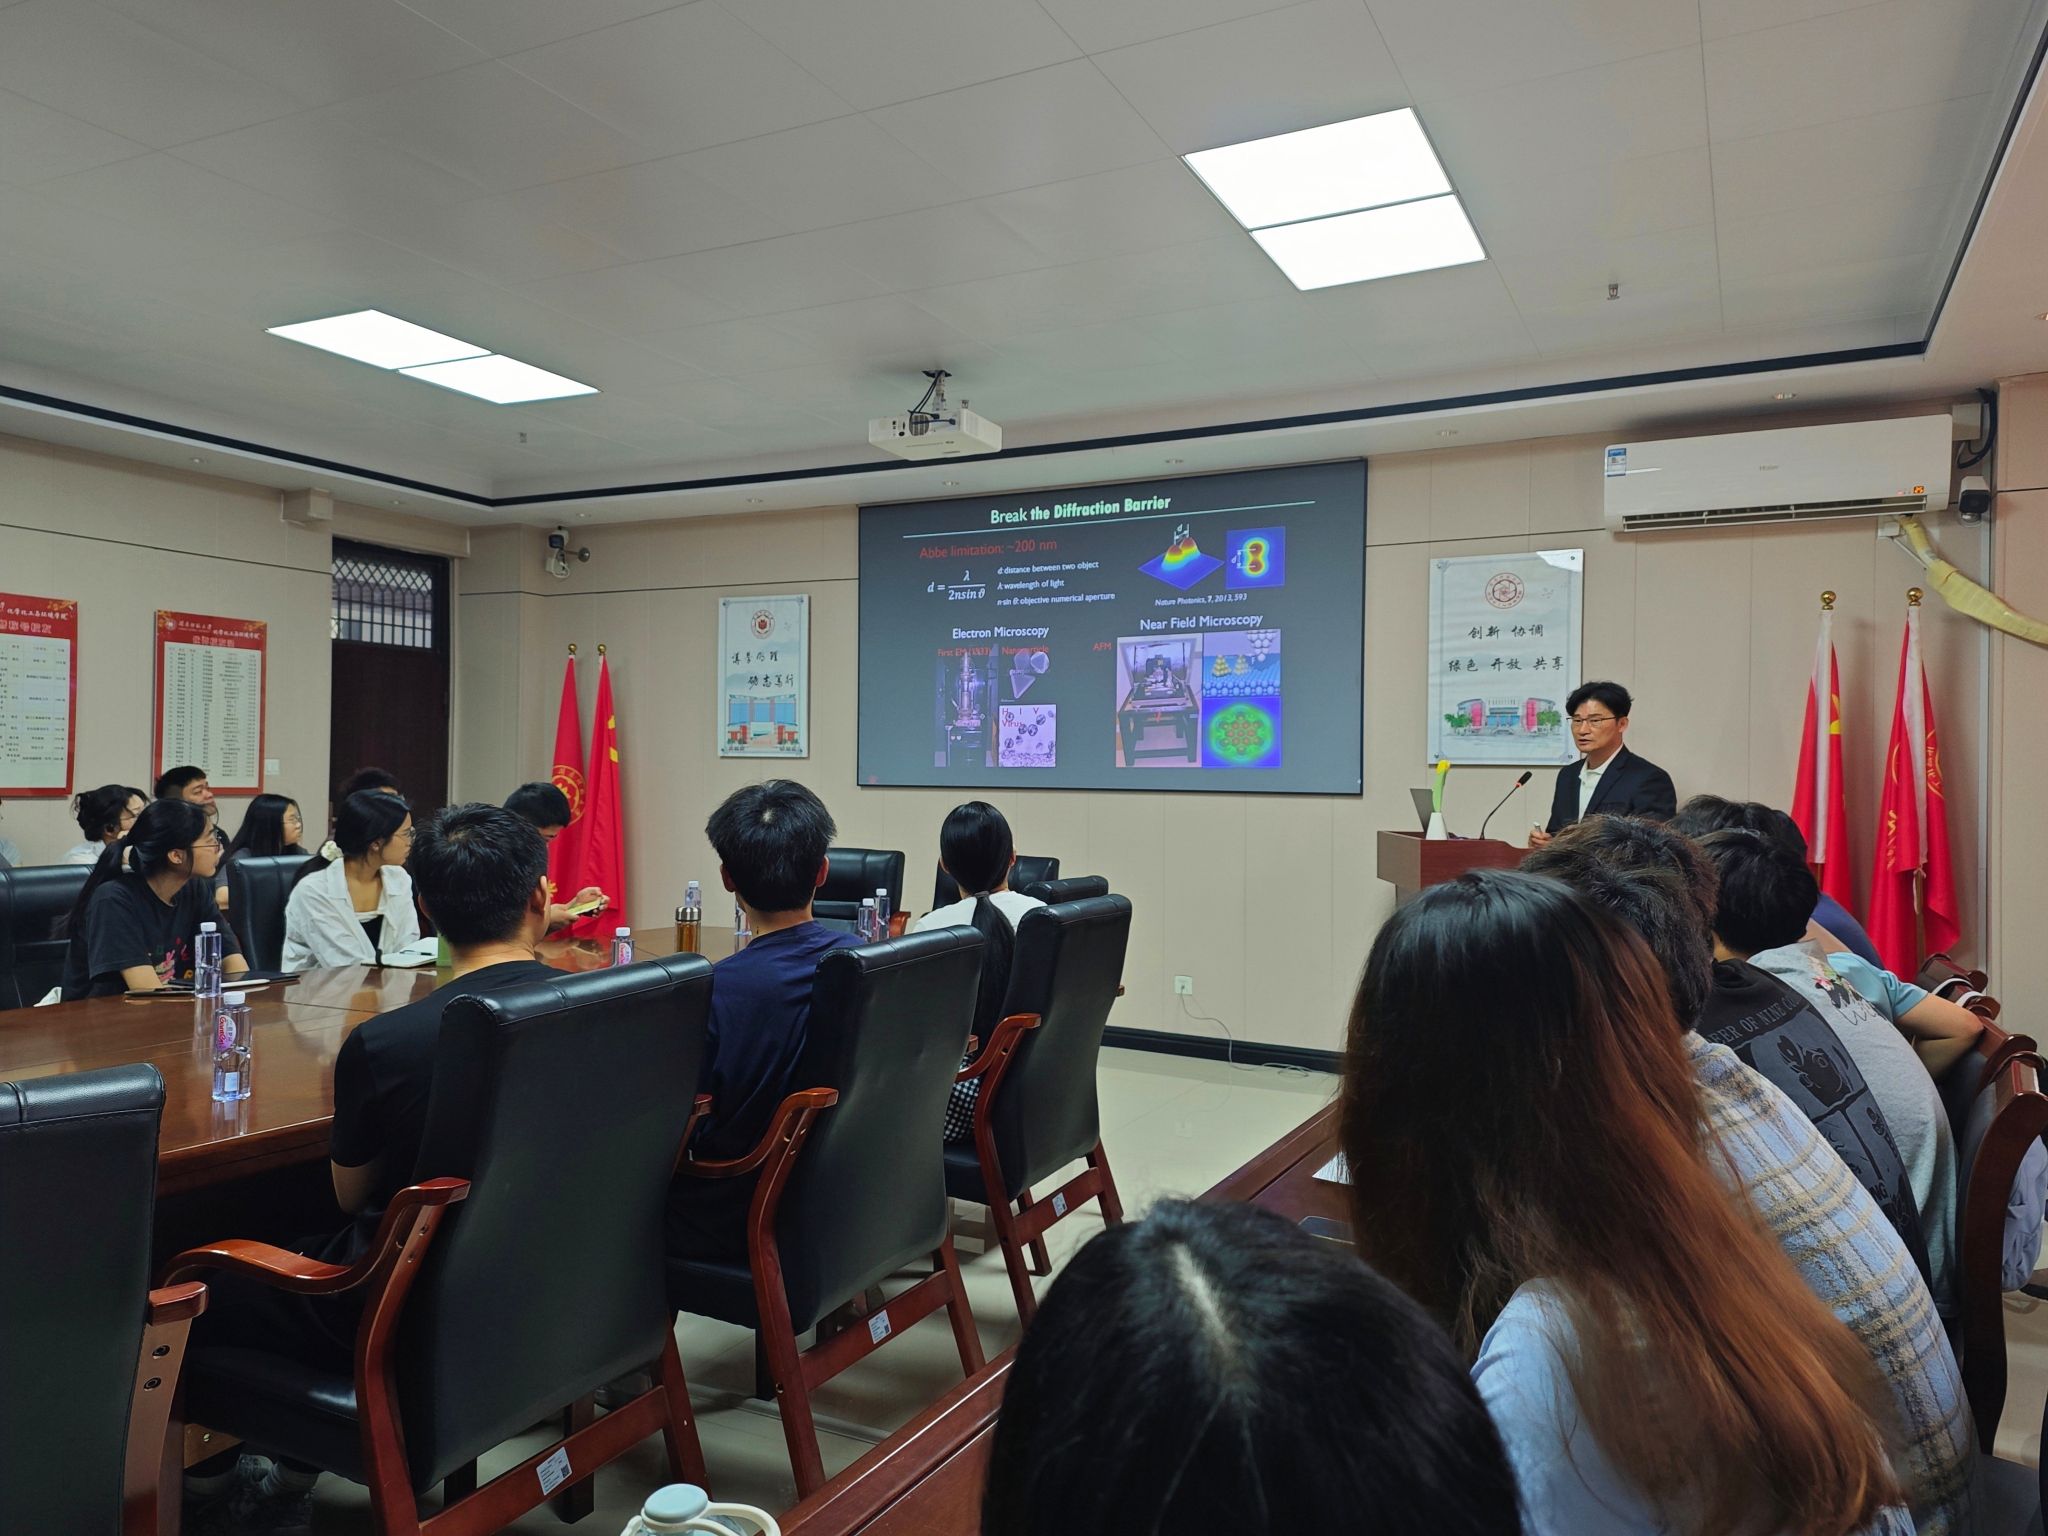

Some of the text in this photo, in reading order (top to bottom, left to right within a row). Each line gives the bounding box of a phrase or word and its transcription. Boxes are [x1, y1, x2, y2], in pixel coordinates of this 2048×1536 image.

[990, 495, 1172, 524] Break the Diffraction Barrier
[920, 547, 948, 558] Abbe
[950, 544, 1005, 557] limitation:
[1039, 540, 1057, 550] nm
[1032, 564, 1061, 573] between
[1077, 561, 1099, 571] object
[1041, 579, 1049, 588] of
[1050, 579, 1065, 589] light
[1020, 596, 1049, 606] objective
[1051, 593, 1084, 603] numerical
[1085, 592, 1116, 602] aperture
[1140, 615, 1263, 630] Near Field Microscopy
[952, 626, 1049, 639] Electron Microscopy
[1468, 623, 1544, 640] 创新 协调
[938, 648, 954, 656] First
[1092, 642, 1112, 651] AFM
[1448, 655, 1564, 672] 绿色 开放 共享
[1708, 1025, 1743, 1044] EER
[1739, 1016, 1761, 1033] OF
[1756, 1002, 1787, 1026] NINE
